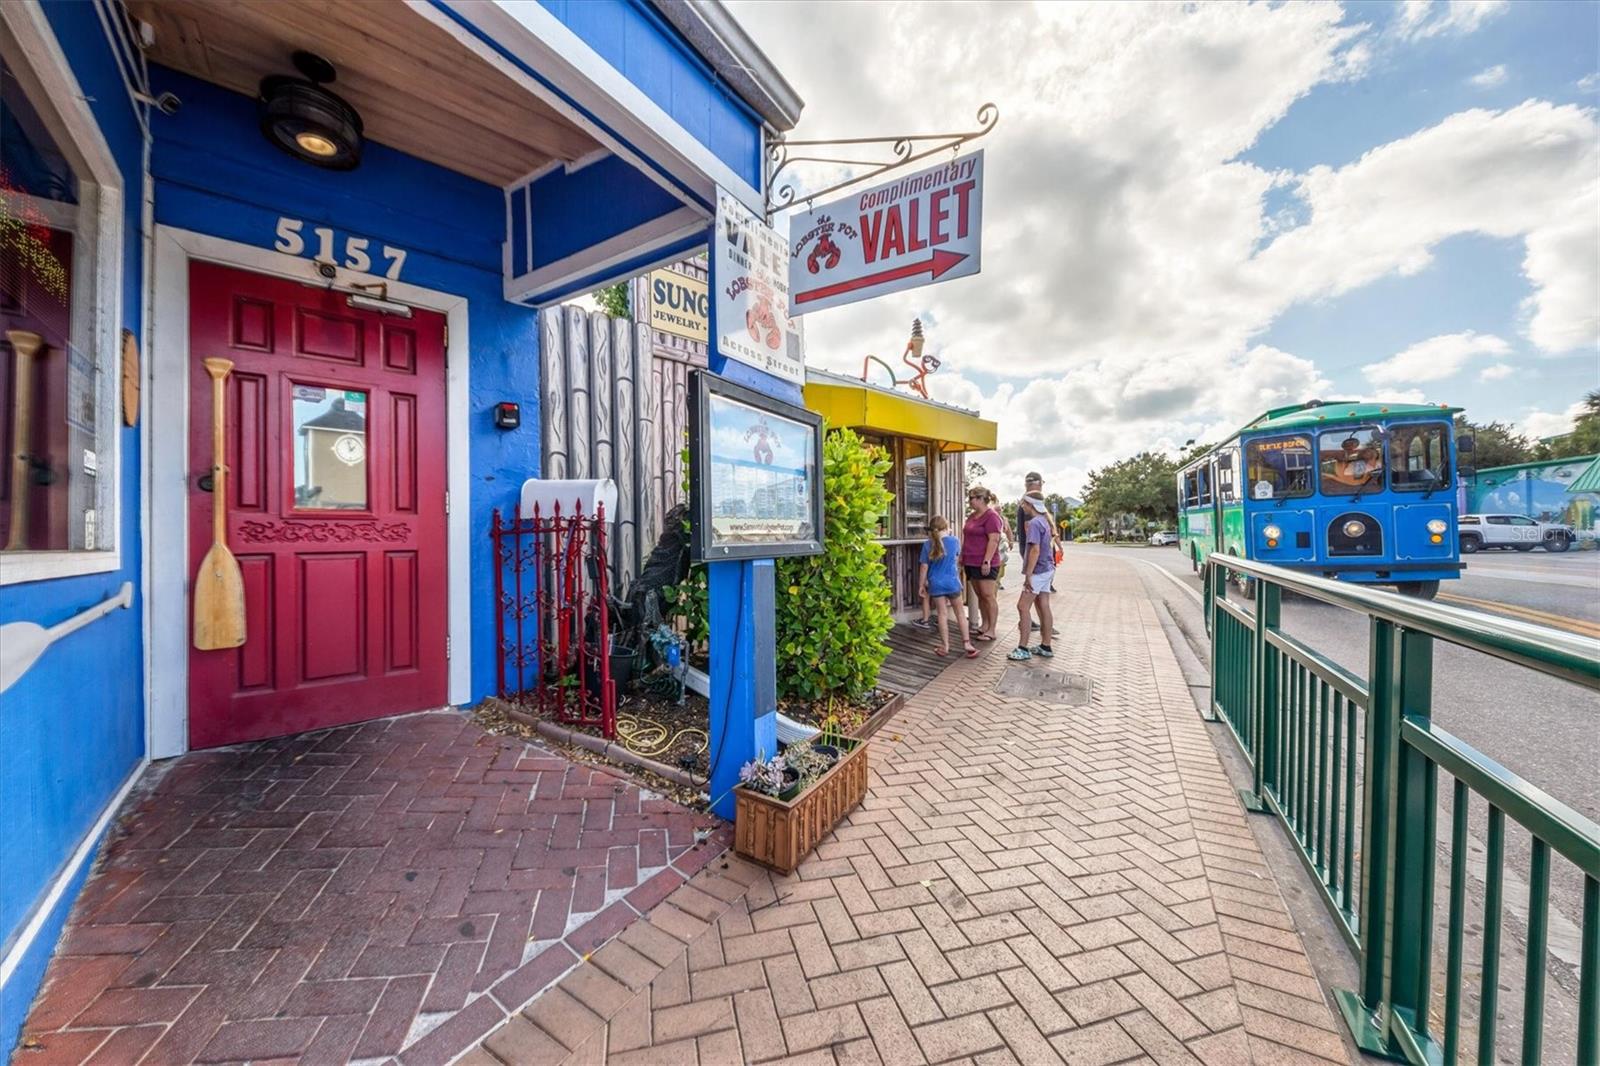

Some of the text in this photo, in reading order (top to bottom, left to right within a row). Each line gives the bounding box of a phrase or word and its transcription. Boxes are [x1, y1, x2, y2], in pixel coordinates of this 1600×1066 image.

[860, 158, 977, 212] Complimentary
[791, 222, 858, 258] LOBSTER POT
[816, 214, 831, 225] the
[859, 180, 976, 265] VALET
[274, 216, 407, 281] 5157
[725, 216, 788, 277] VALE
[728, 248, 752, 270] DINNER
[653, 310, 701, 331] JEWELRY
[722, 335, 799, 376] Across Street
